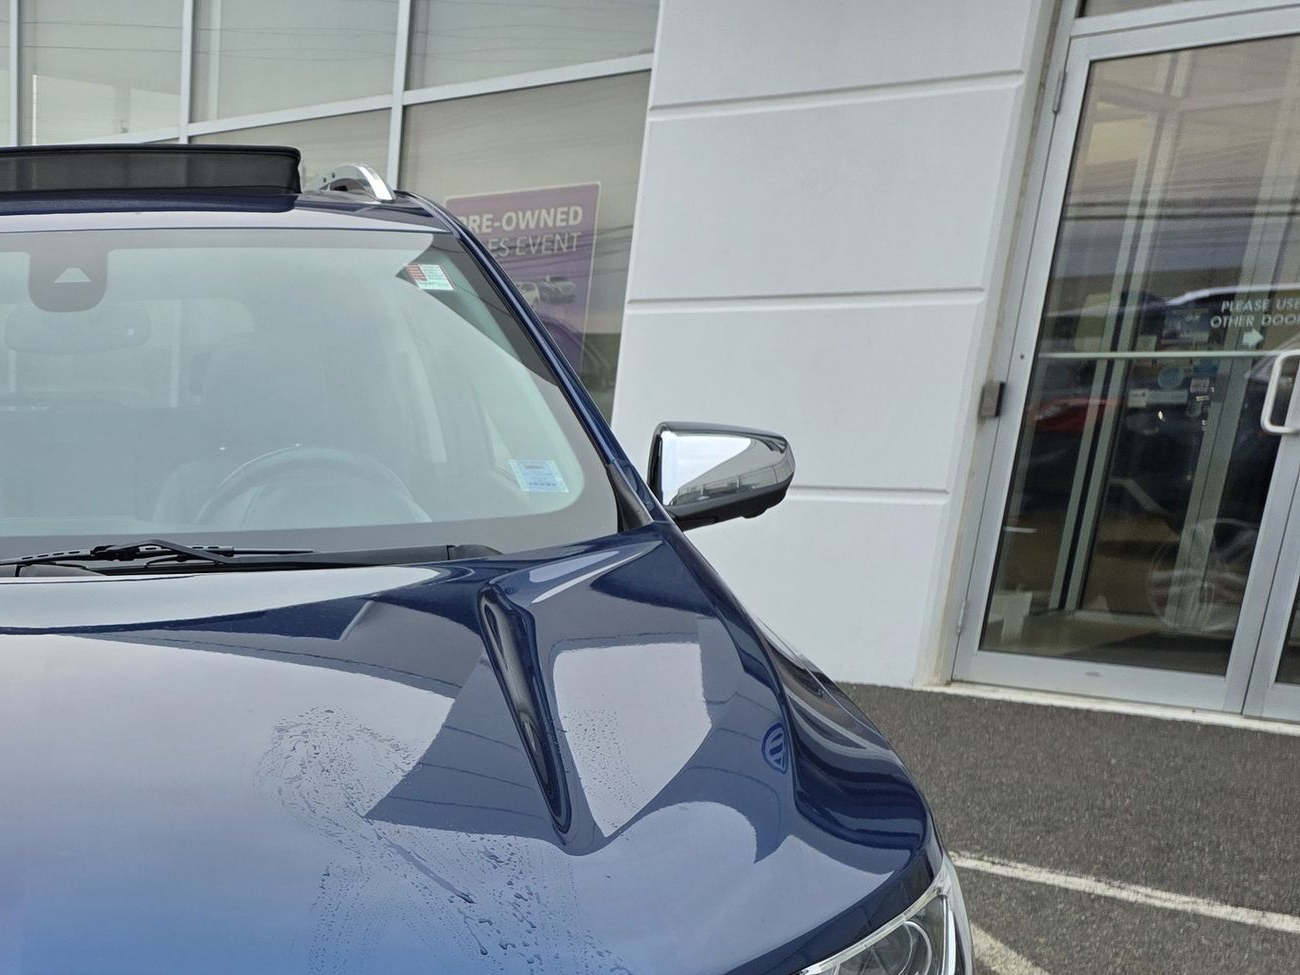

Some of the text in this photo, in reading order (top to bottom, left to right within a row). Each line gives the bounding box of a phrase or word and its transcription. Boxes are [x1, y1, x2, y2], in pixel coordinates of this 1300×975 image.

[515, 232, 582, 256] EVENT
[1221, 299, 1270, 313] PLEASE
[1210, 314, 1255, 328] OTHER
